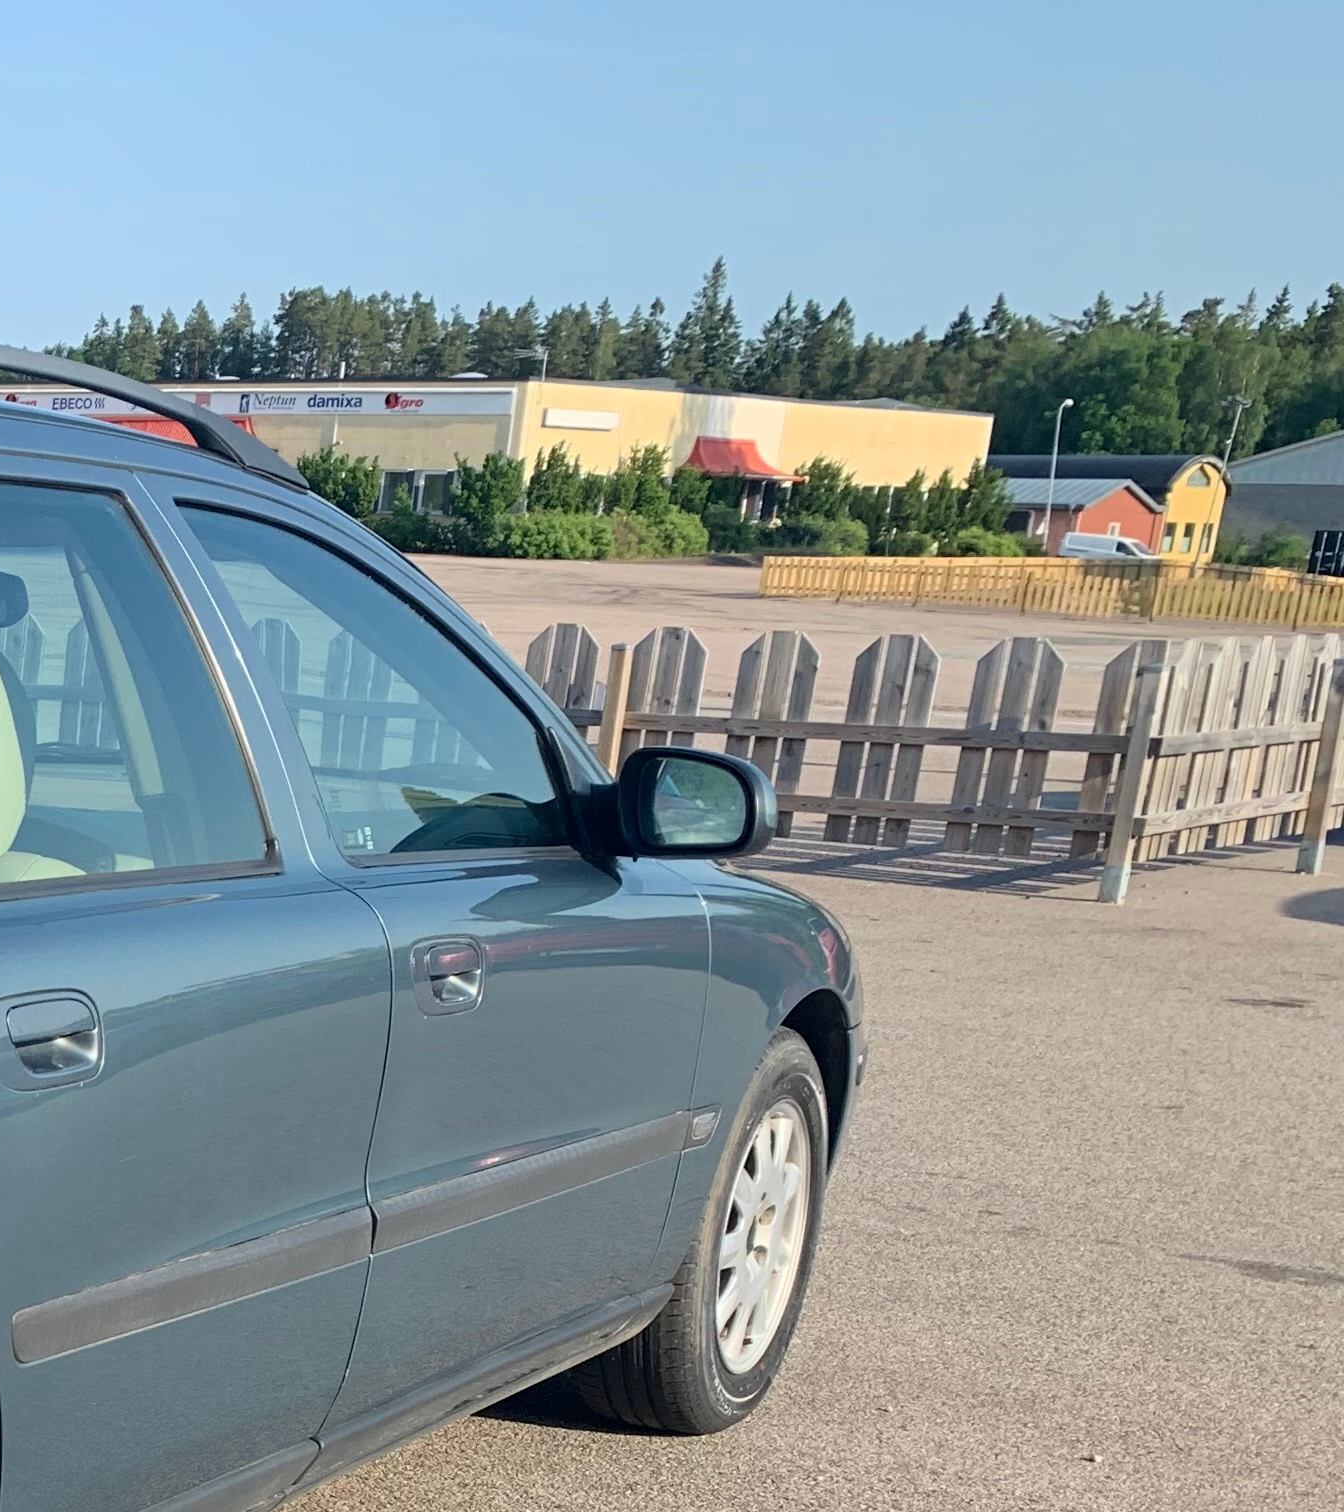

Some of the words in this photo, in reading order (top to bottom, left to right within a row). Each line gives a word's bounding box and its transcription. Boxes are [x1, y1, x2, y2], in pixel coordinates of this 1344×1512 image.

[51, 397, 92, 410] EBECO
[254, 393, 297, 409] Neptun
[307, 393, 363, 408] damixa
